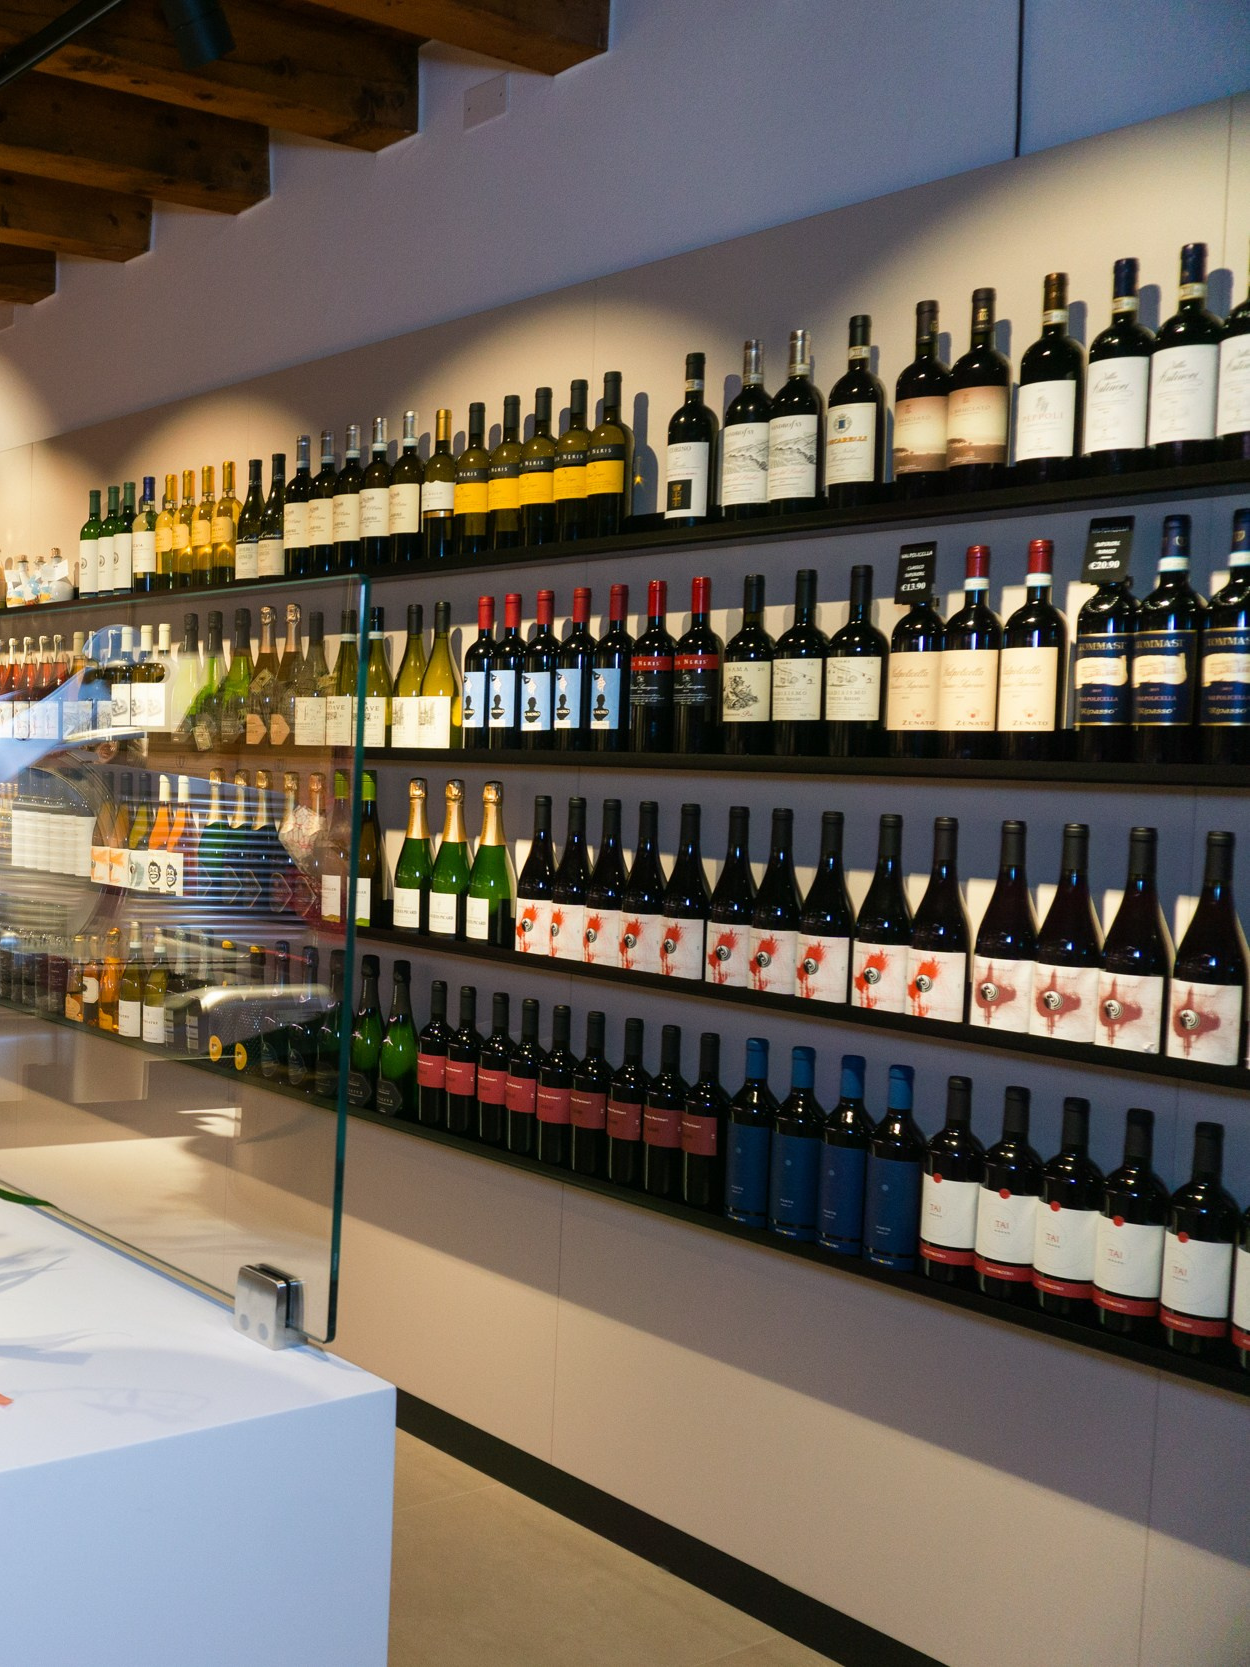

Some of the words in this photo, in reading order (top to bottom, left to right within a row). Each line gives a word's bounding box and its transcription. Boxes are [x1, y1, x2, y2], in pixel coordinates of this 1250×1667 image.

[1022, 412, 1063, 423] PEPPOLI
[1088, 560, 1120, 570] €20.90
[901, 582, 926, 591] €13.90
[930, 1204, 941, 1213] TAI
[996, 1220, 1010, 1229] TAI
[1046, 1233, 1059, 1243] TAI
[1108, 1249, 1123, 1259] TAI
[1173, 1266, 1187, 1276] TAI
